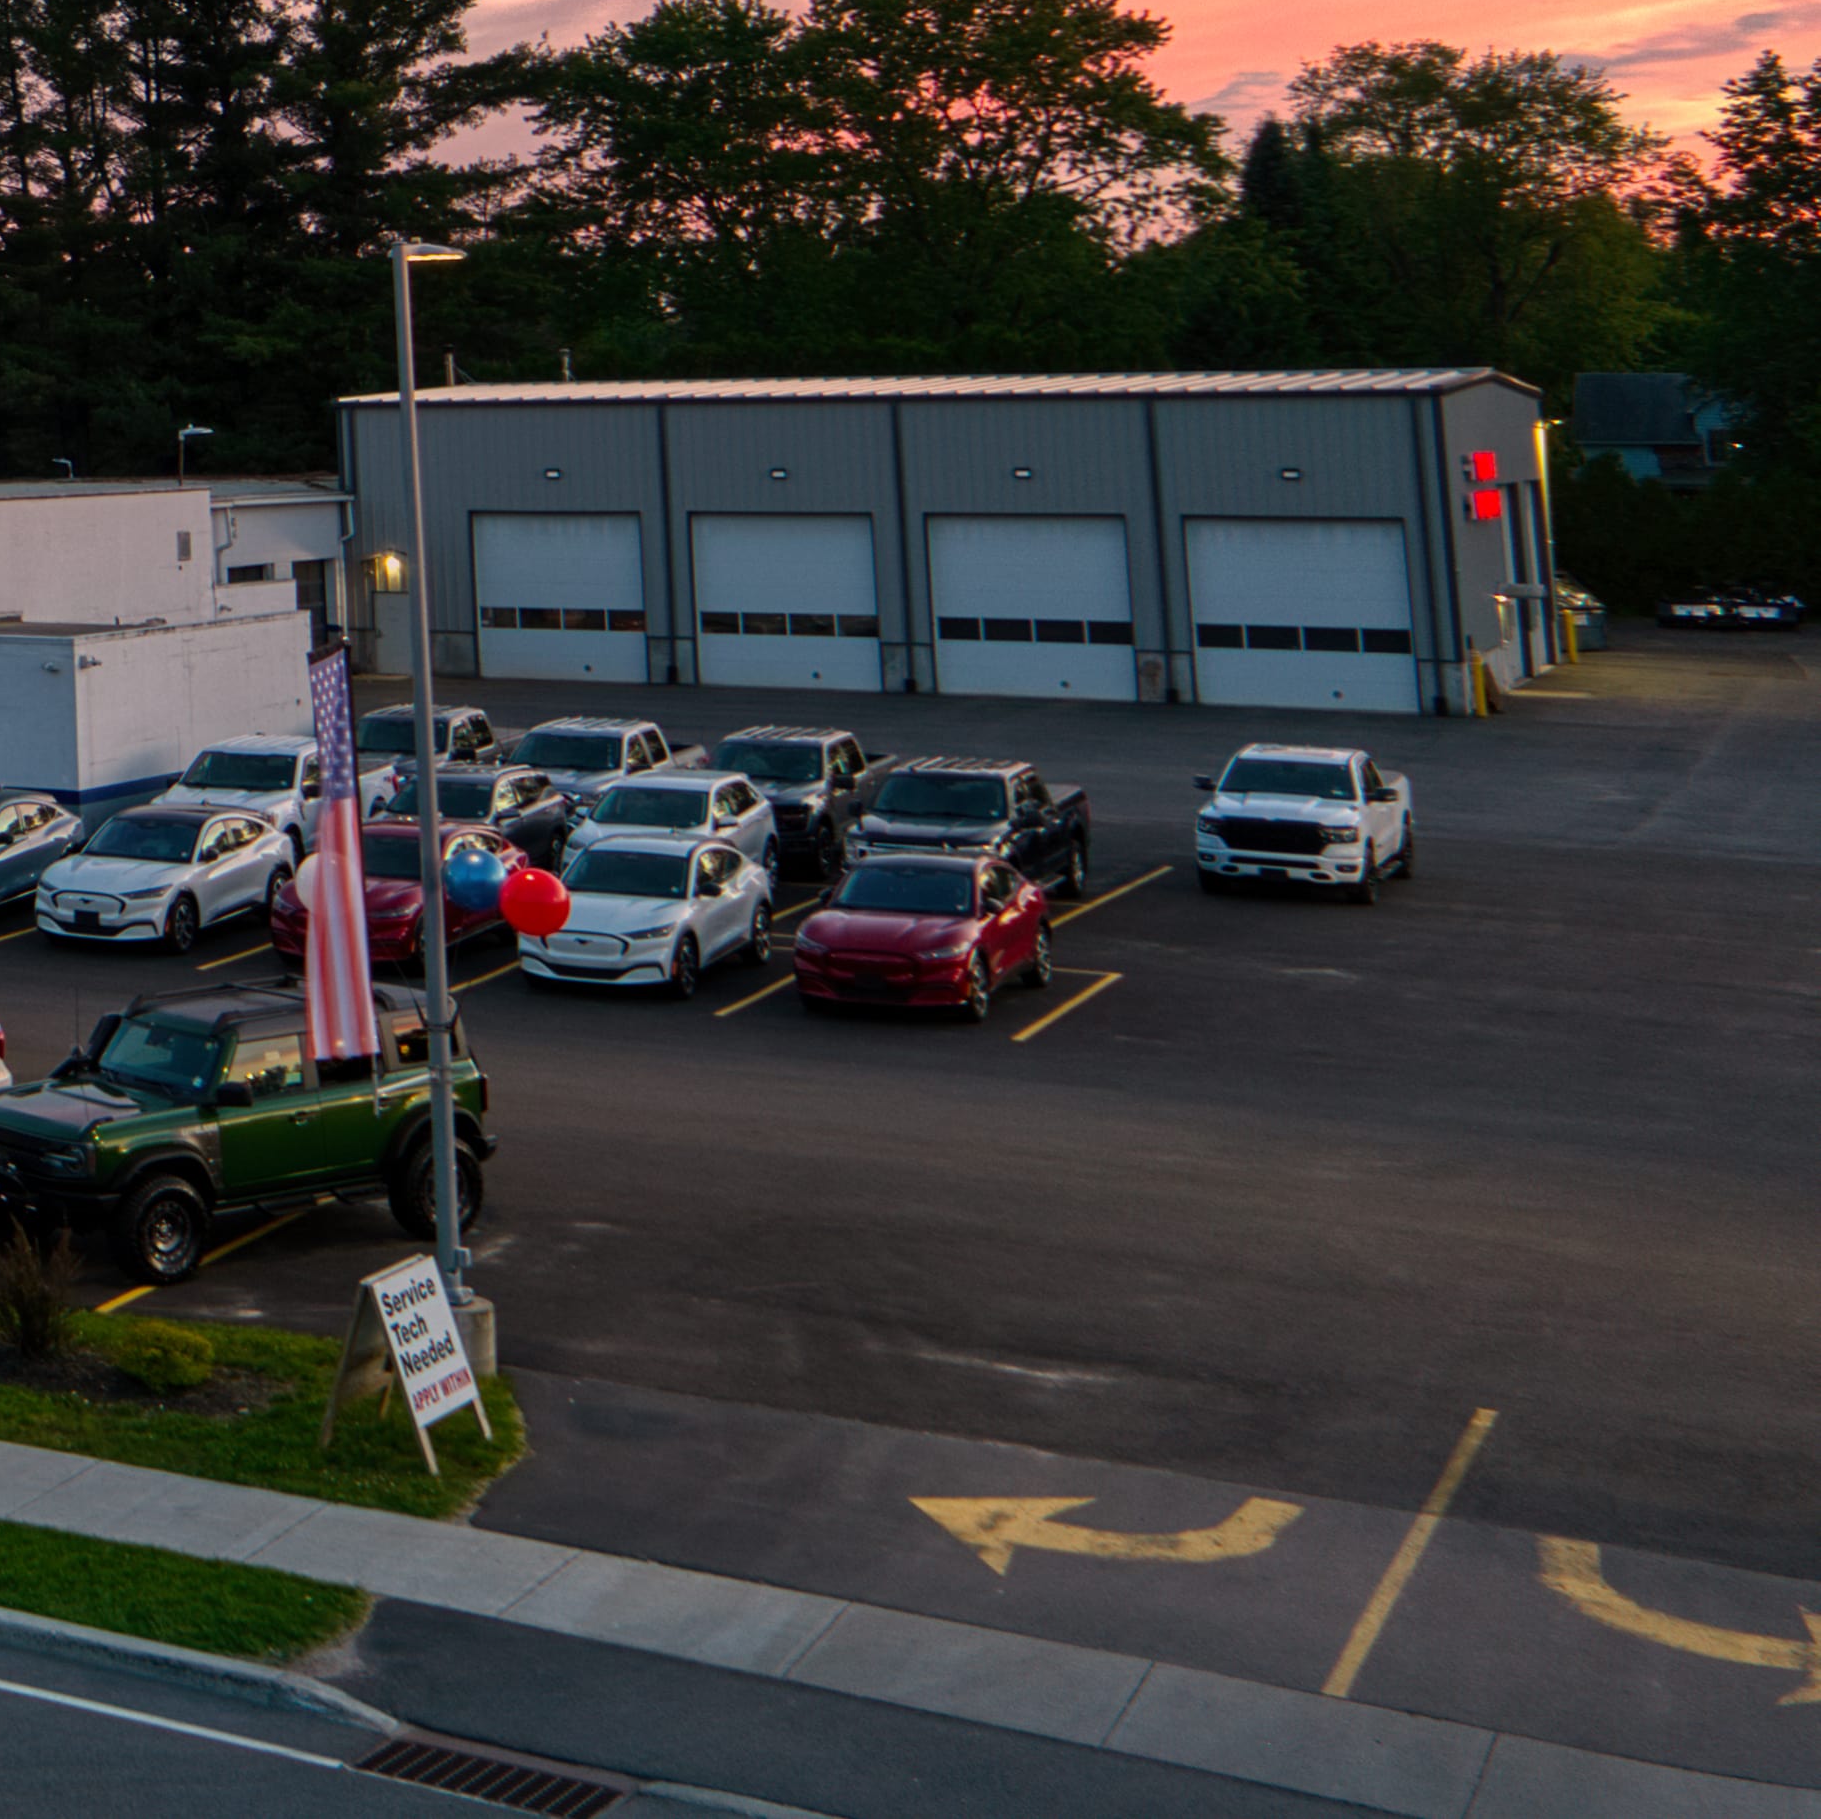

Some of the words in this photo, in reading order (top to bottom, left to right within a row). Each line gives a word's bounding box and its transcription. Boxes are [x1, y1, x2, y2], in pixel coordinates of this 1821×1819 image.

[381, 1277, 436, 1316] Service
[391, 1313, 428, 1346] Tech
[399, 1331, 455, 1378] Needed
[413, 1383, 440, 1411] APPLY
[442, 1367, 472, 1397] WITHIN
